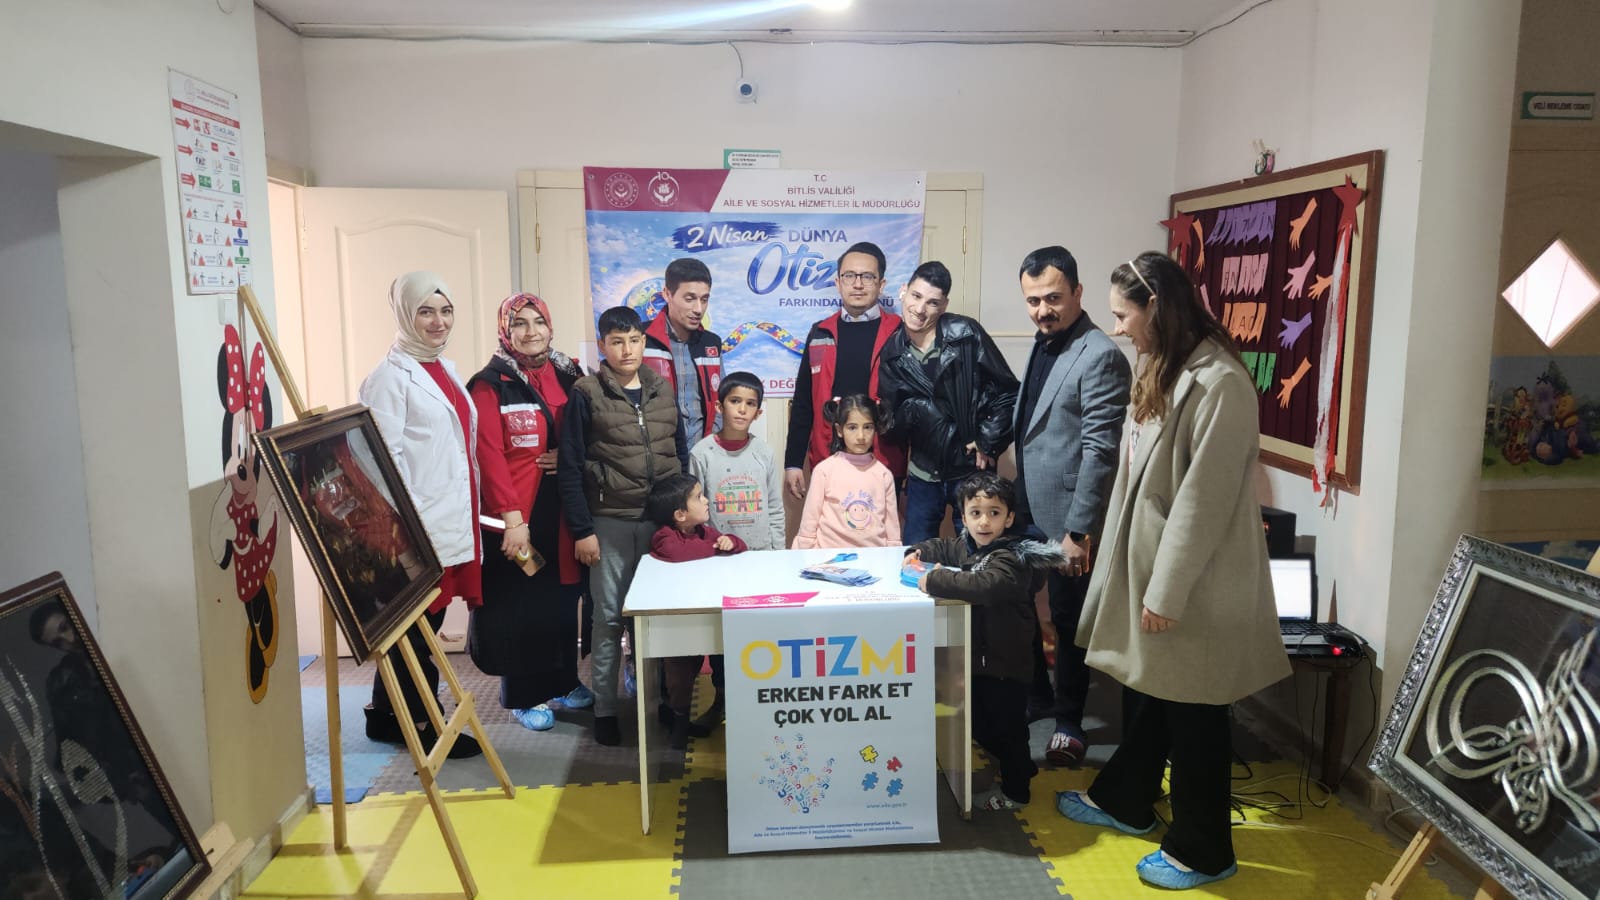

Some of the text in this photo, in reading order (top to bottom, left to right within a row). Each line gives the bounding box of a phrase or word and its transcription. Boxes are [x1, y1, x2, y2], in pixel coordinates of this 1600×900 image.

[787, 186, 856, 195] BİTLİS VALİLİĞİ
[723, 198, 921, 208] AİLE VE SOSYAL HİZMETLER İL MÜDÜRLÜĞÜ
[687, 224, 770, 249] 2 Nisan
[788, 226, 848, 243] DÜNYA
[747, 241, 838, 295] Otiz
[714, 489, 763, 514] BRAVE
[757, 682, 913, 704] ERKEN FARK ET
[774, 705, 892, 728] ÇOK YOL AL
